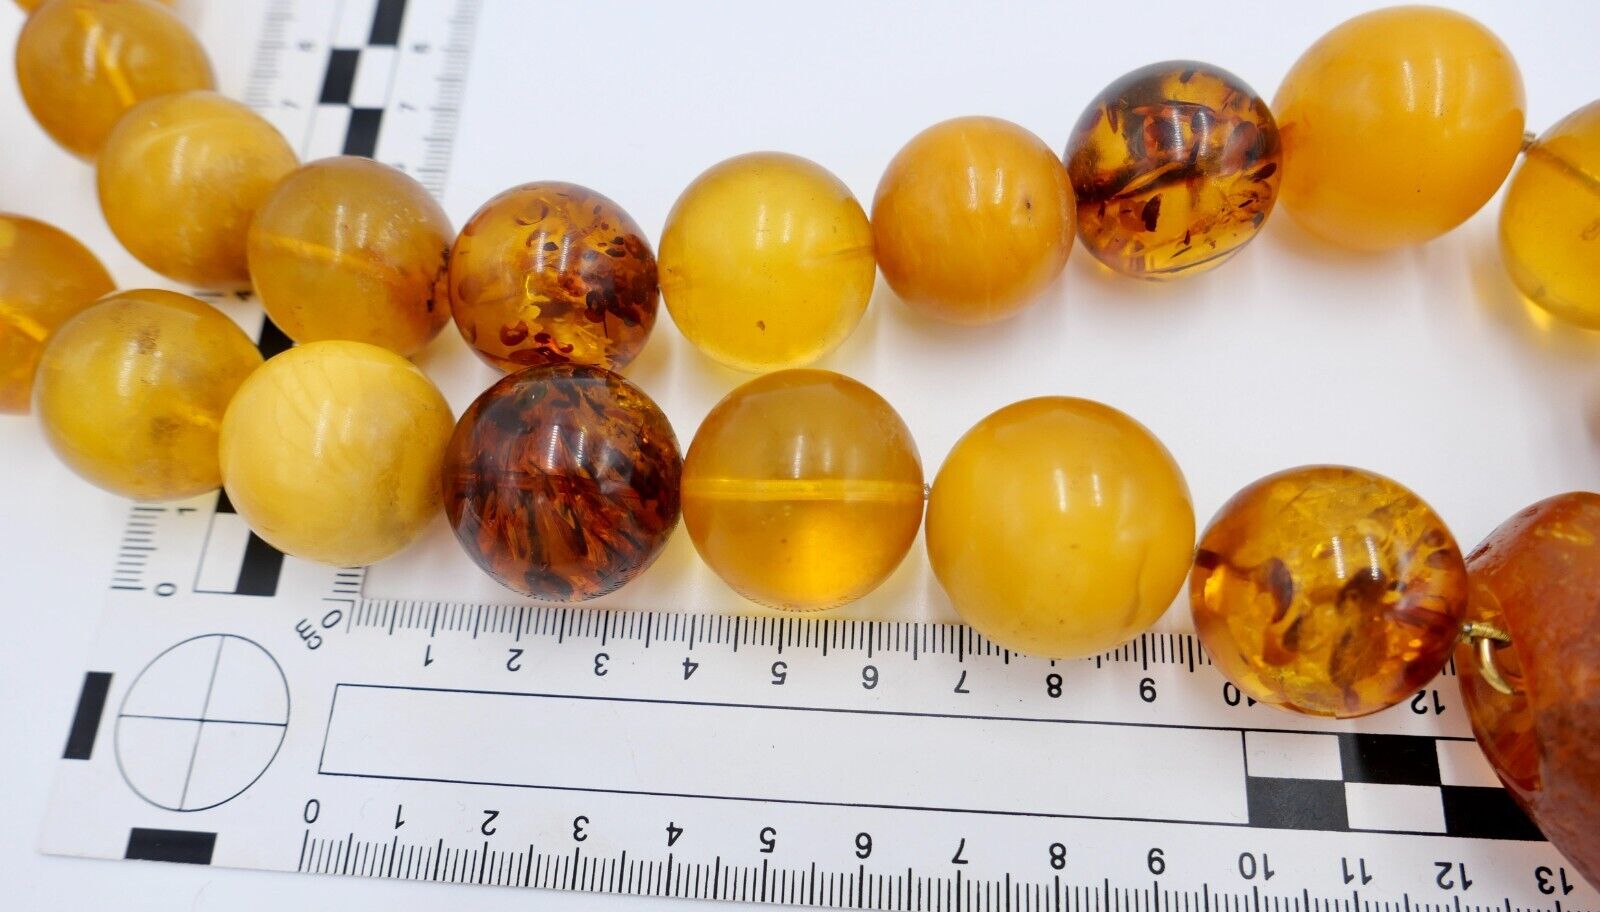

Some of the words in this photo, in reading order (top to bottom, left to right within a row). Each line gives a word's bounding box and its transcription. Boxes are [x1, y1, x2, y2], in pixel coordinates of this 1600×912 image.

[177, 507, 197, 516] 1
[154, 582, 177, 597] 0
[321, 610, 343, 628] 0
[295, 618, 322, 650] cm
[424, 645, 433, 666] 1
[507, 649, 523, 671] 2
[595, 653, 609, 676] 3
[683, 658, 698, 680] 4
[772, 661, 787, 685] 5
[862, 665, 878, 689] 6
[954, 670, 969, 693] 7
[1046, 674, 1062, 698] 8
[1140, 678, 1156, 702] 9
[1411, 690, 1446, 715] 12
[304, 799, 320, 823] 0
[395, 805, 404, 829] 1
[481, 810, 499, 836] 2
[573, 816, 589, 841] 3
[666, 822, 683, 846] 4
[760, 827, 776, 853] 5
[855, 833, 872, 859] 6
[952, 838, 968, 864] 7
[1049, 843, 1066, 870] 8
[1148, 848, 1165, 875] 9
[1239, 852, 1274, 880] 10
[1342, 858, 1372, 885] 11
[1435, 862, 1472, 890] 12
[1535, 866, 1574, 895] 13
